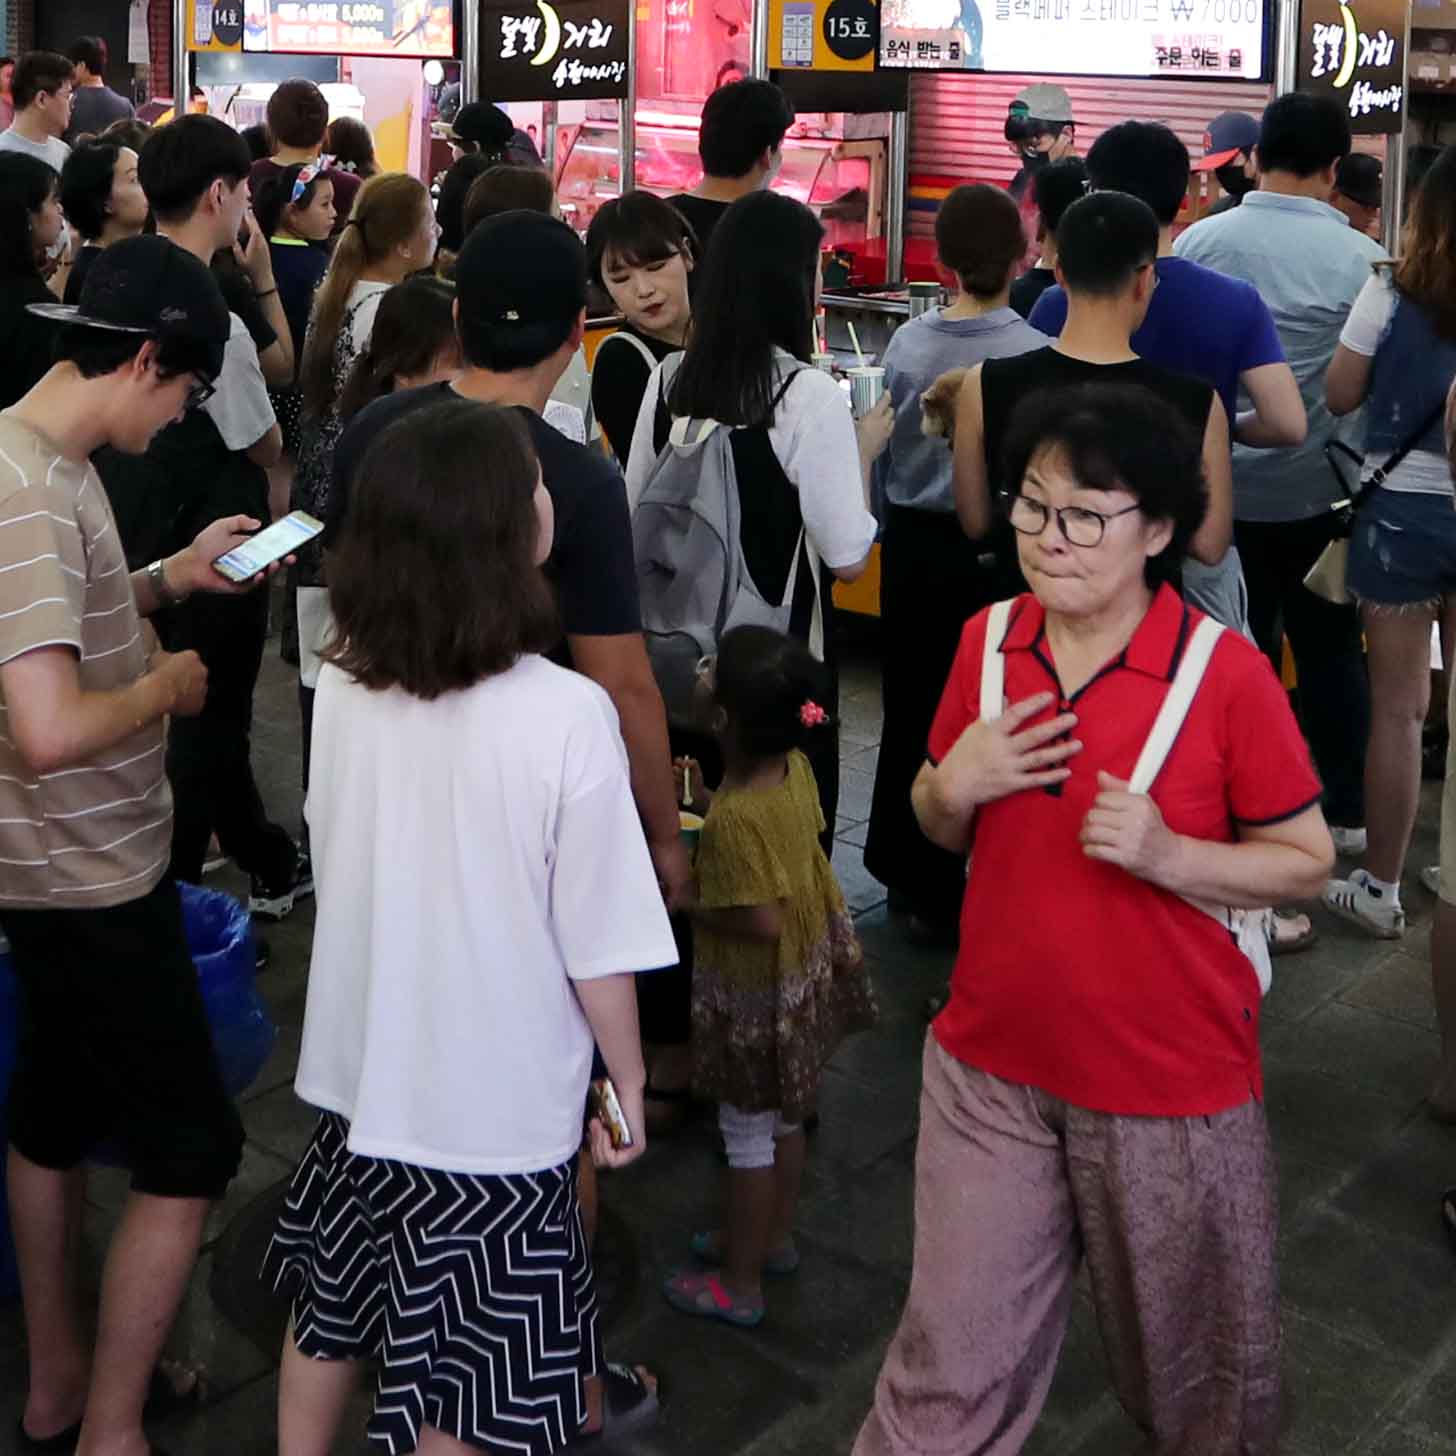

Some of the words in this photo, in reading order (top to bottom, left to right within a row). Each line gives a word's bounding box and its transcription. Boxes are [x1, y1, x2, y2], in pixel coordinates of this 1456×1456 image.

[828, 16, 872, 39] 15호
[886, 39, 911, 59] 음식
[916, 39, 941, 60] 받는
[1155, 46, 1182, 66] 주문
